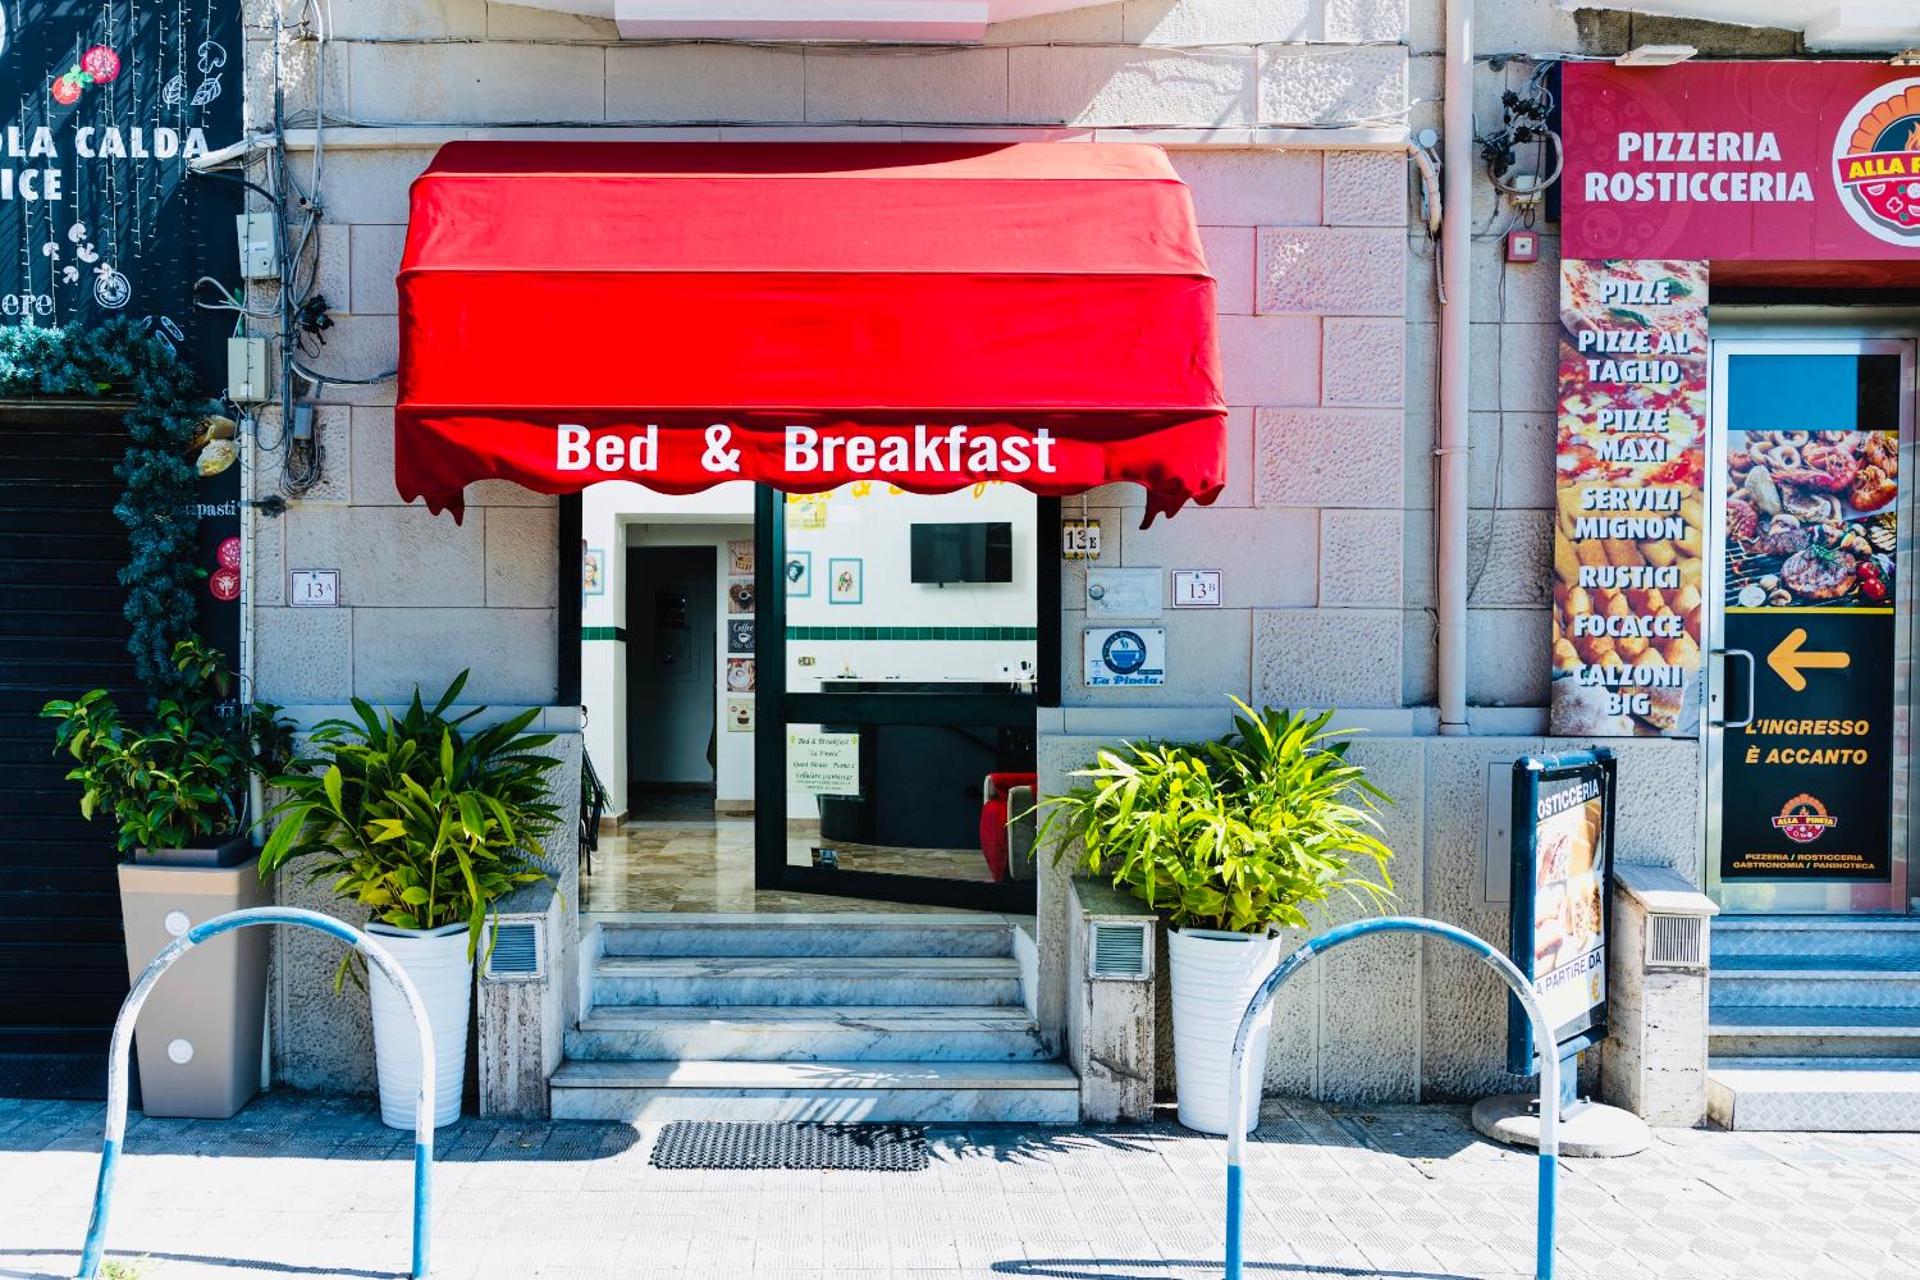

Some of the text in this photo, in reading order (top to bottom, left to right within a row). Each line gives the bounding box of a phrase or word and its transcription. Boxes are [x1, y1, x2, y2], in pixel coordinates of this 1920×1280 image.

[0, 126, 210, 158] LA CALDA
[1618, 132, 1782, 162] PIZZERIA
[1849, 157, 1906, 179] ALLA
[1, 168, 62, 201] ICE
[1584, 172, 1815, 202] ROSTICCERIA
[0, 294, 53, 316] ere
[1600, 281, 1672, 305] PIZZE
[1578, 329, 1691, 354] PIZZE AL
[1586, 359, 1683, 384] TAGLIO
[1597, 409, 1670, 433] PIZZE
[556, 424, 1056, 473] Bed & Breakfast
[1597, 438, 1667, 462] MAXI
[1580, 487, 1682, 512] SERVIZI
[1575, 516, 1685, 540] MIGNON
[1578, 566, 1681, 589] RUSTICI
[1574, 614, 1684, 638] FOCACCE
[1573, 664, 1684, 687] CALZONI
[1606, 693, 1652, 716] BIG
[1745, 719, 1870, 736] L'INGRESSO
[1745, 744, 1869, 765] È ACCANTO
[1537, 779, 1600, 819] OSTICCERIA
[1777, 817, 1799, 825] ALLA
[1733, 861, 1805, 869] GASTRONOMIA
[1813, 862, 1875, 870] PANINOTECA
[1745, 853, 1789, 861] PIZZERIA
[1797, 853, 1863, 862] ROSTICCERIA
[1545, 959, 1587, 992] PARTIRE
[1588, 951, 1602, 970] DA
